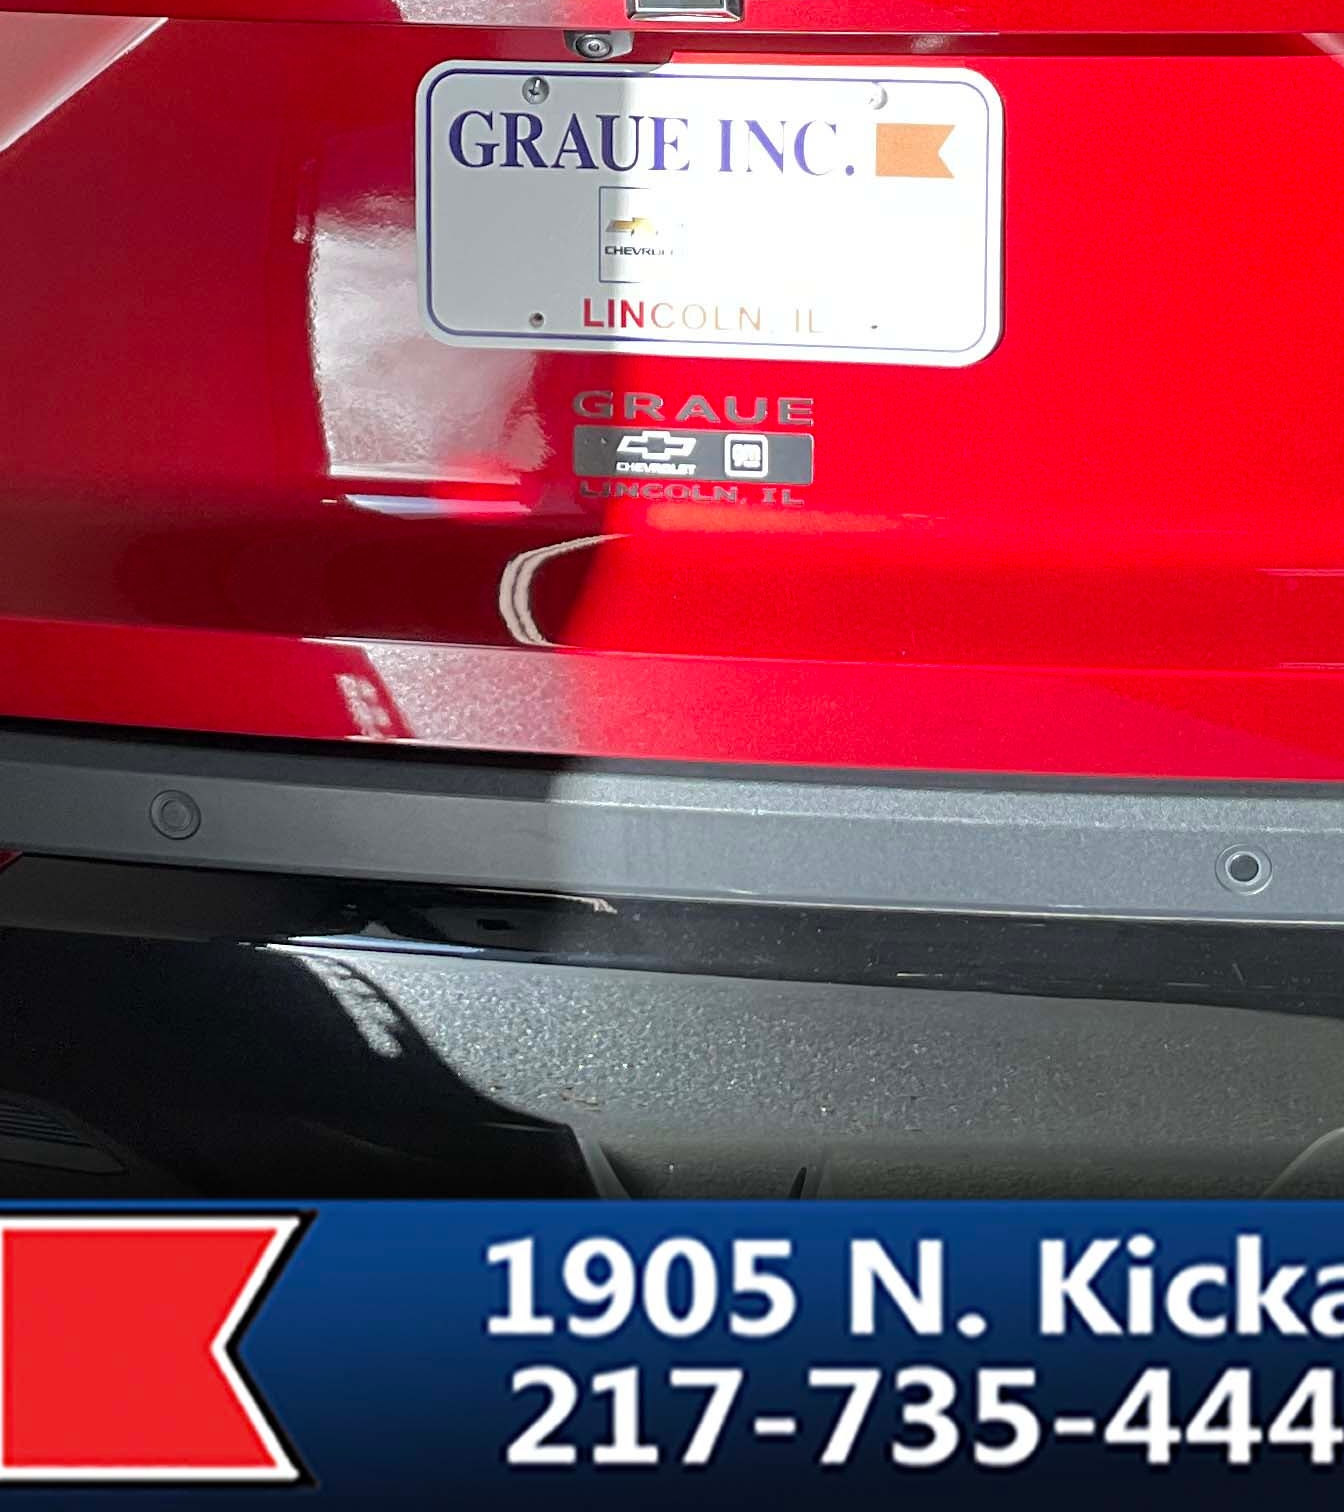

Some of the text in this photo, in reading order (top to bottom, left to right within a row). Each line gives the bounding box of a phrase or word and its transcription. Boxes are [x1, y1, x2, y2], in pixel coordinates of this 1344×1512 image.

[448, 109, 856, 177] GRAUE INC.
[794, 307, 825, 334] IL
[571, 390, 814, 426] GRAUE
[761, 487, 806, 506] IL
